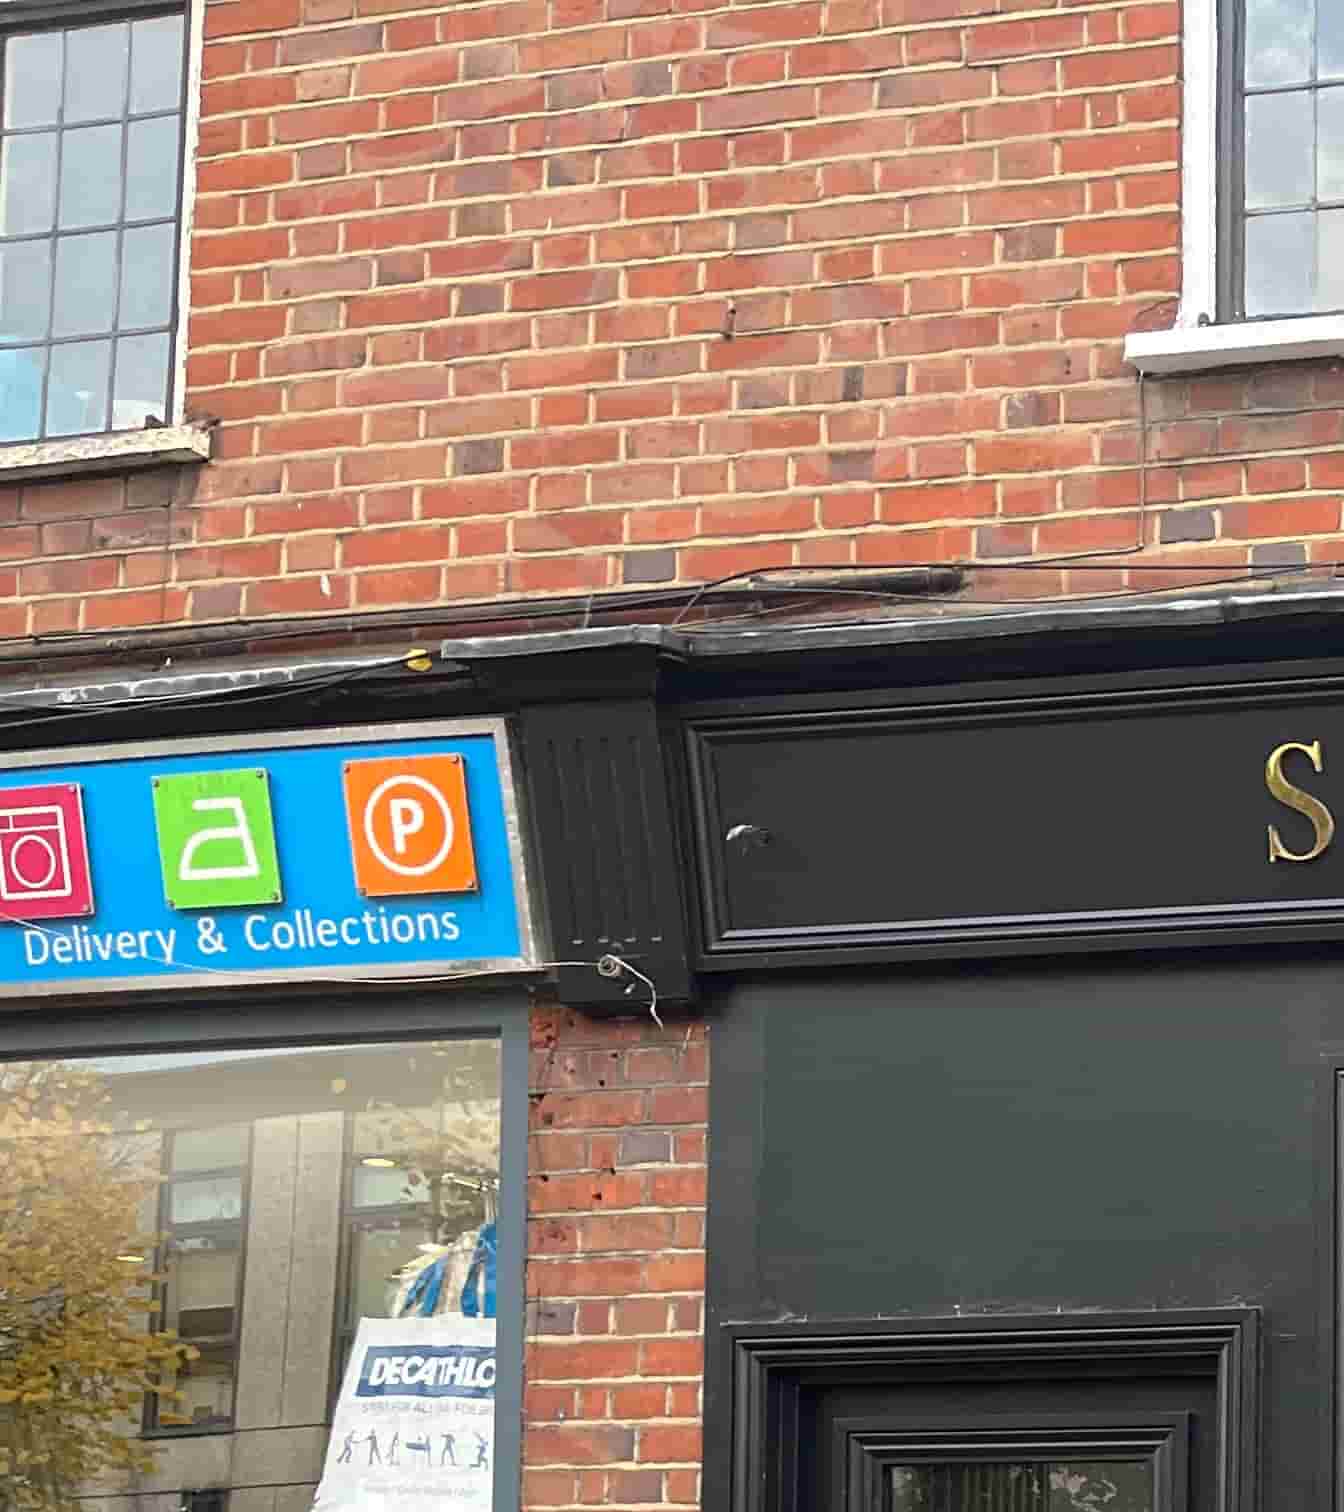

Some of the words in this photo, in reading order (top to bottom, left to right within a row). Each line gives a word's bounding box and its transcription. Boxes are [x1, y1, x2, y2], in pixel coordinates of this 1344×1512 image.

[24, 924, 176, 965] Delivery
[197, 917, 226, 954] &
[245, 910, 459, 953] Collections
